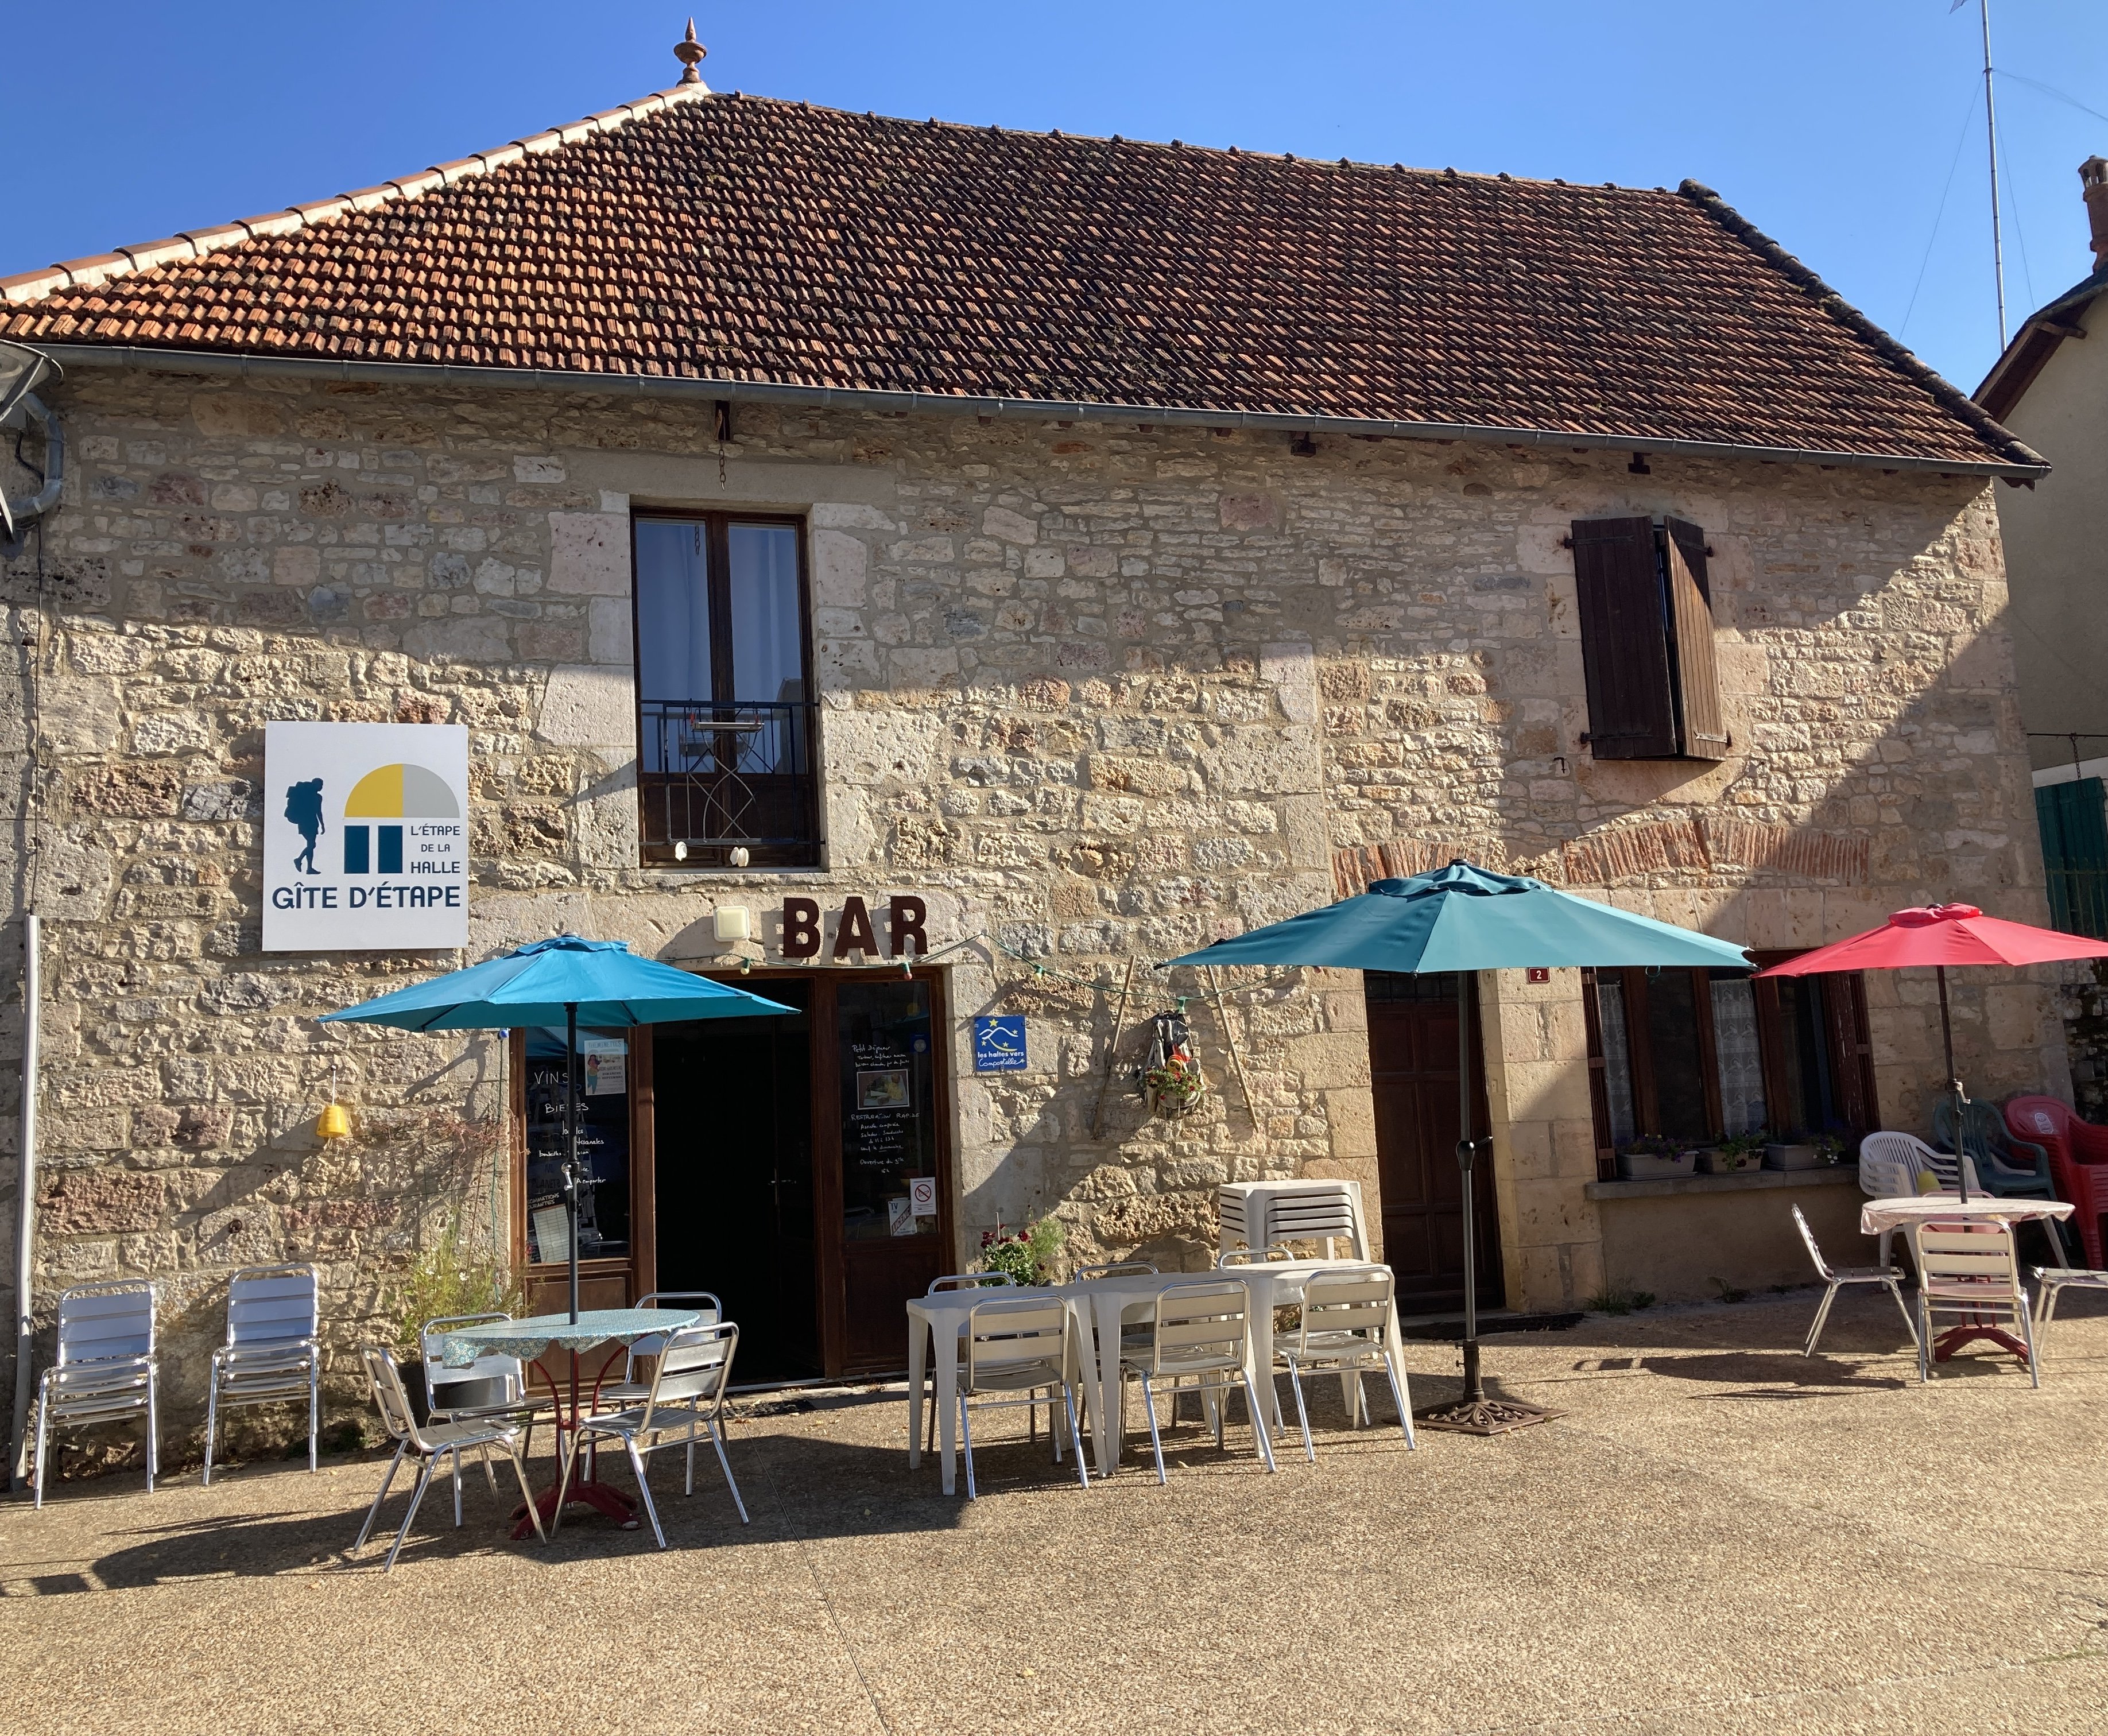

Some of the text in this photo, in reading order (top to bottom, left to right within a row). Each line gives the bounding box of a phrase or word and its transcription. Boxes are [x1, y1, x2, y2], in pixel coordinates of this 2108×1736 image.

[411, 823, 460, 836] L'ÉTAPE
[421, 844, 450, 852] DE LA
[411, 861, 460, 874] HALLE
[272, 881, 460, 909] GÎTE D'ÉTAPE
[783, 896, 928, 958] BAR
[1536, 970, 1542, 979] 2
[852, 1044, 866, 1052] Petit
[979, 1057, 1022, 1068] Compostelle
[534, 1071, 569, 1085] VINS
[545, 1103, 589, 1114] BIEES
[582, 1177, 606, 1185] emporter
